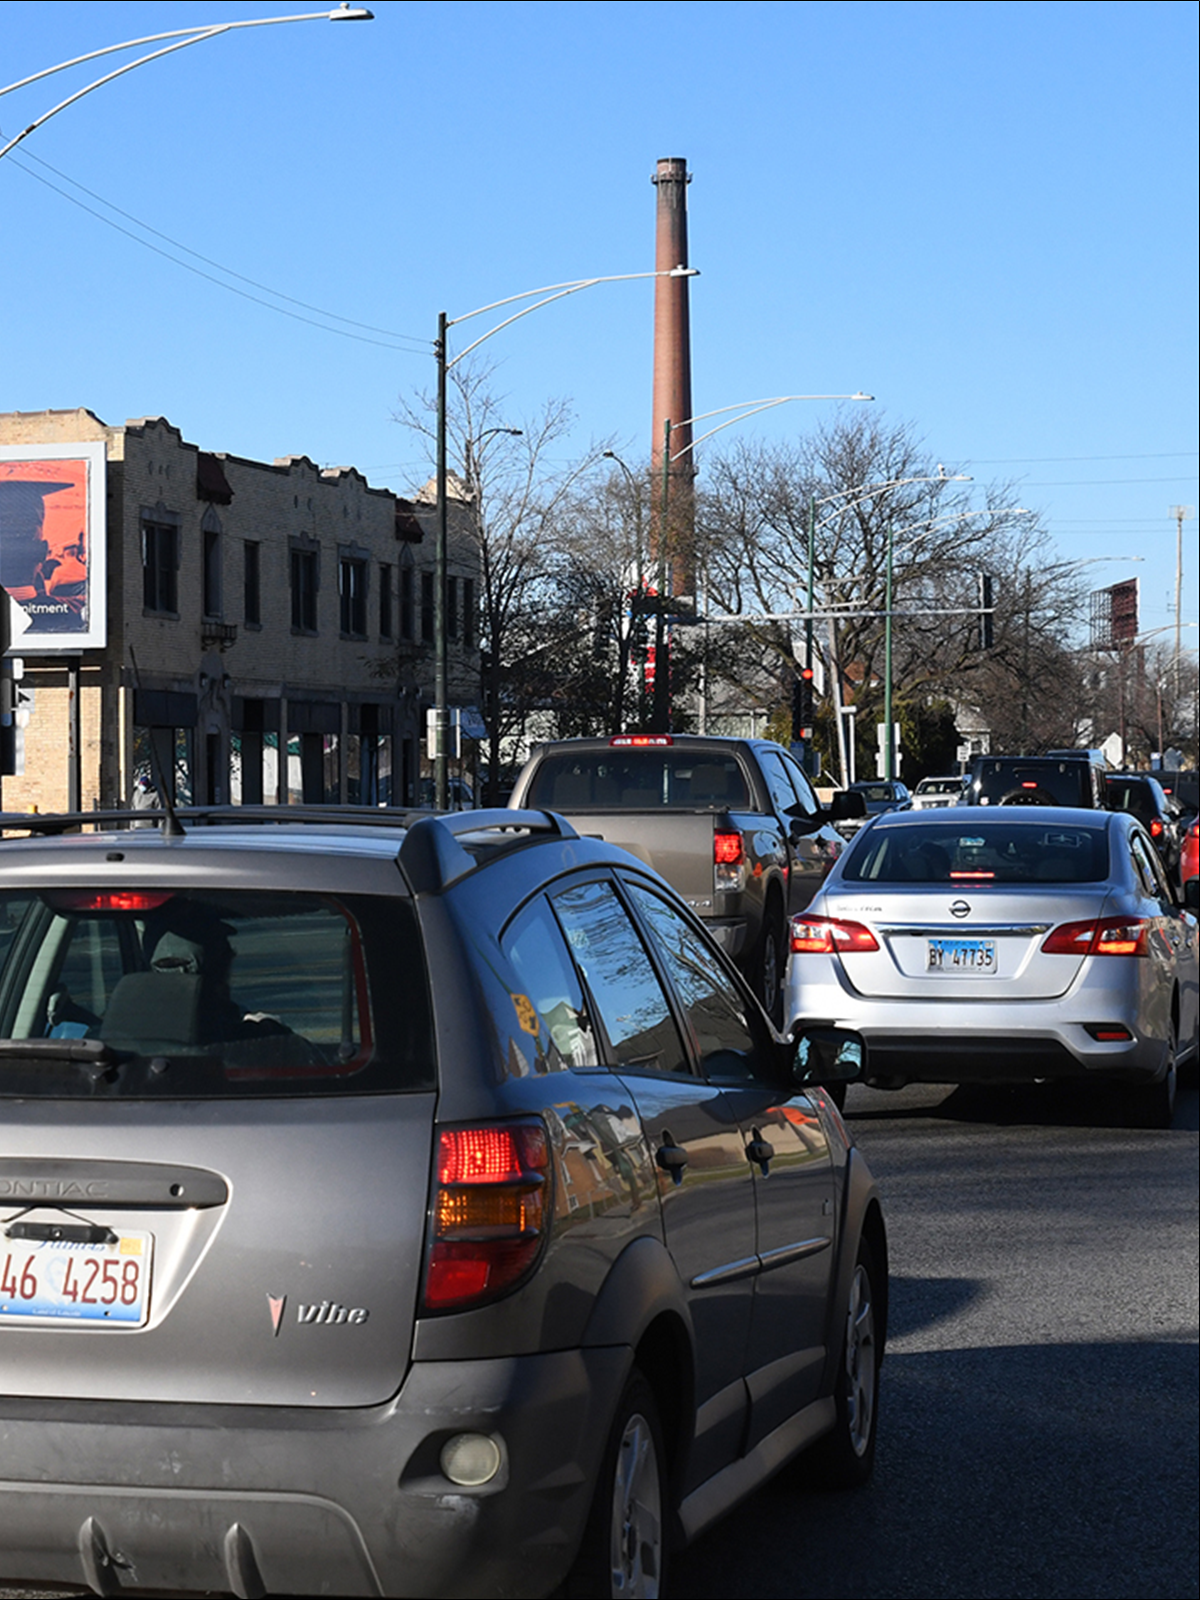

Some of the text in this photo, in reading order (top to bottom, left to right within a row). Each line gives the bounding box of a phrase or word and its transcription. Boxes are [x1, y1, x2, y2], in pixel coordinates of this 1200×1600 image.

[929, 948, 993, 966] BY 47735
[62, 1257, 140, 1306] 4258
